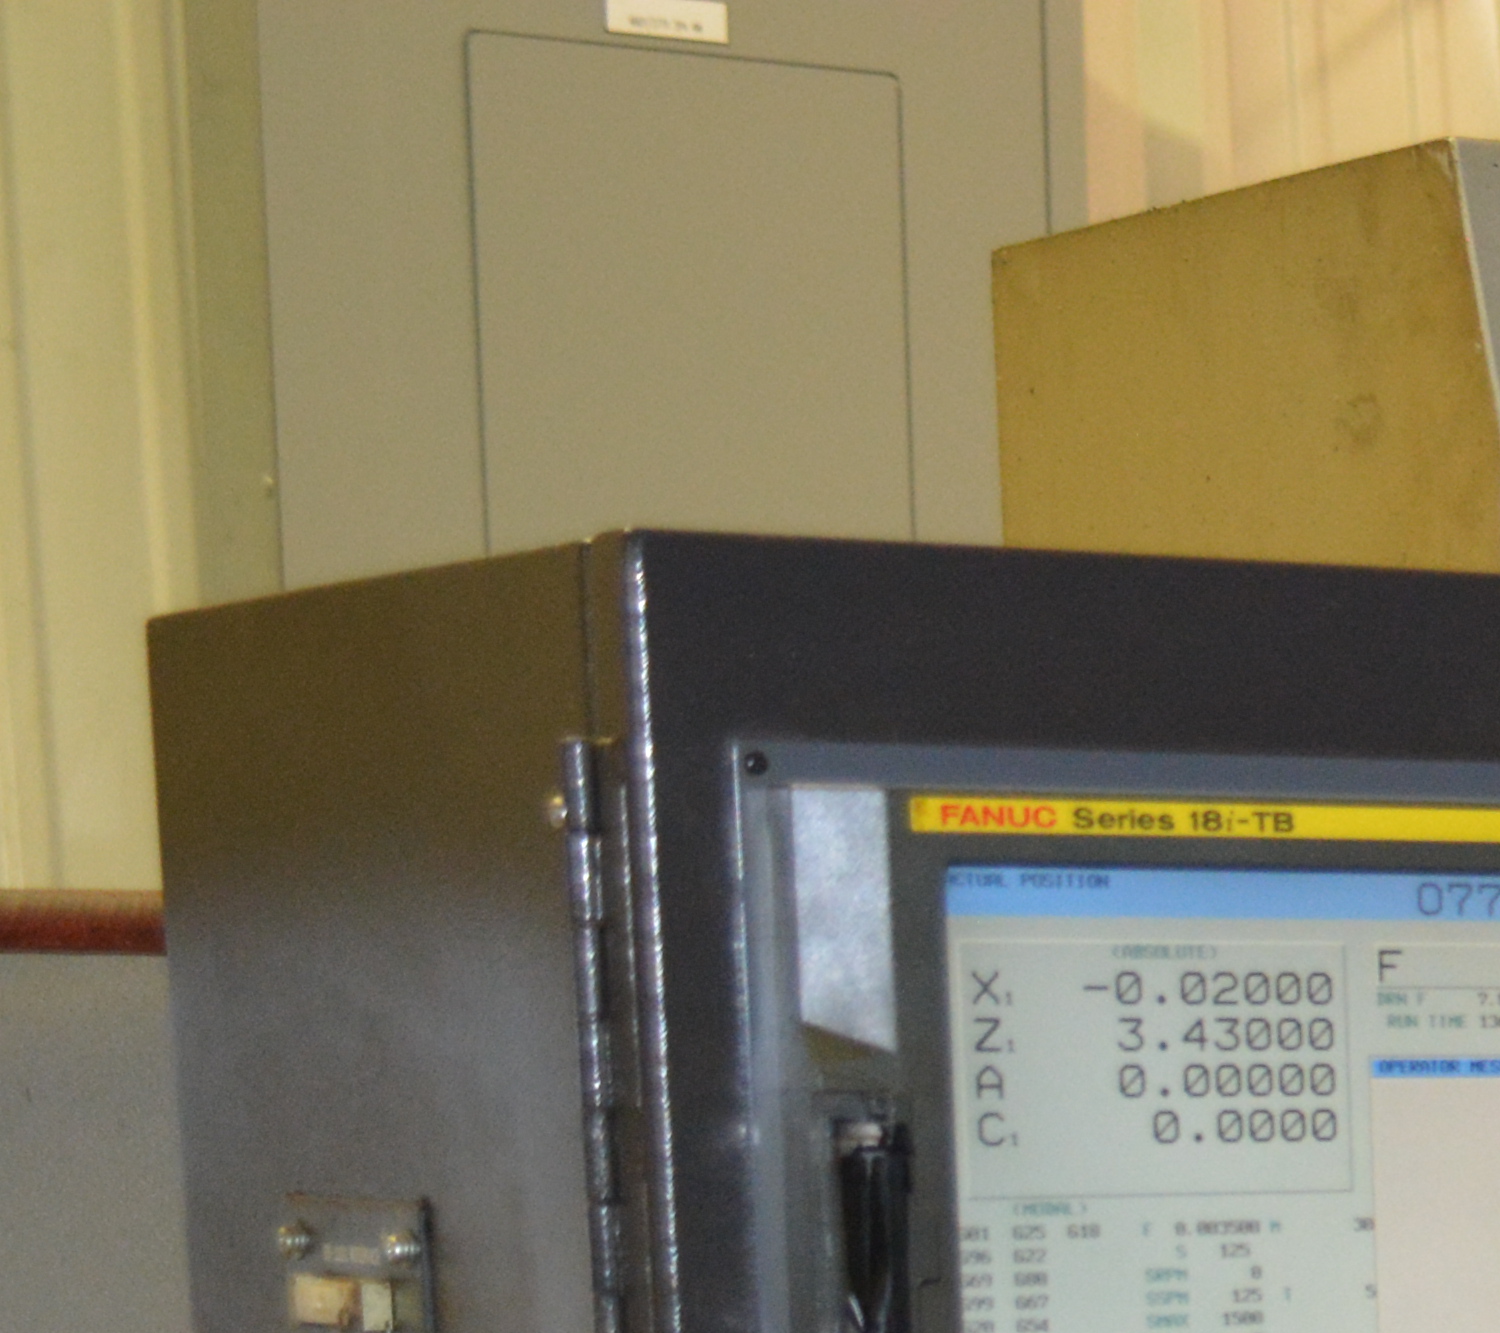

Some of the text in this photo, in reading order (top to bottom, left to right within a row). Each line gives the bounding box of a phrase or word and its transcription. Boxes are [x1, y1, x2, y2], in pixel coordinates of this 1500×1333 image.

[940, 804, 1295, 835] FANUC Series 18i-TB
[1378, 950, 1403, 983] F
[1083, 971, 1332, 1006] -0.02000
[1118, 1017, 1335, 1053] 3.43000
[976, 1063, 1336, 1099] A 0.00000
[1153, 1109, 1337, 1143] 0.0000
